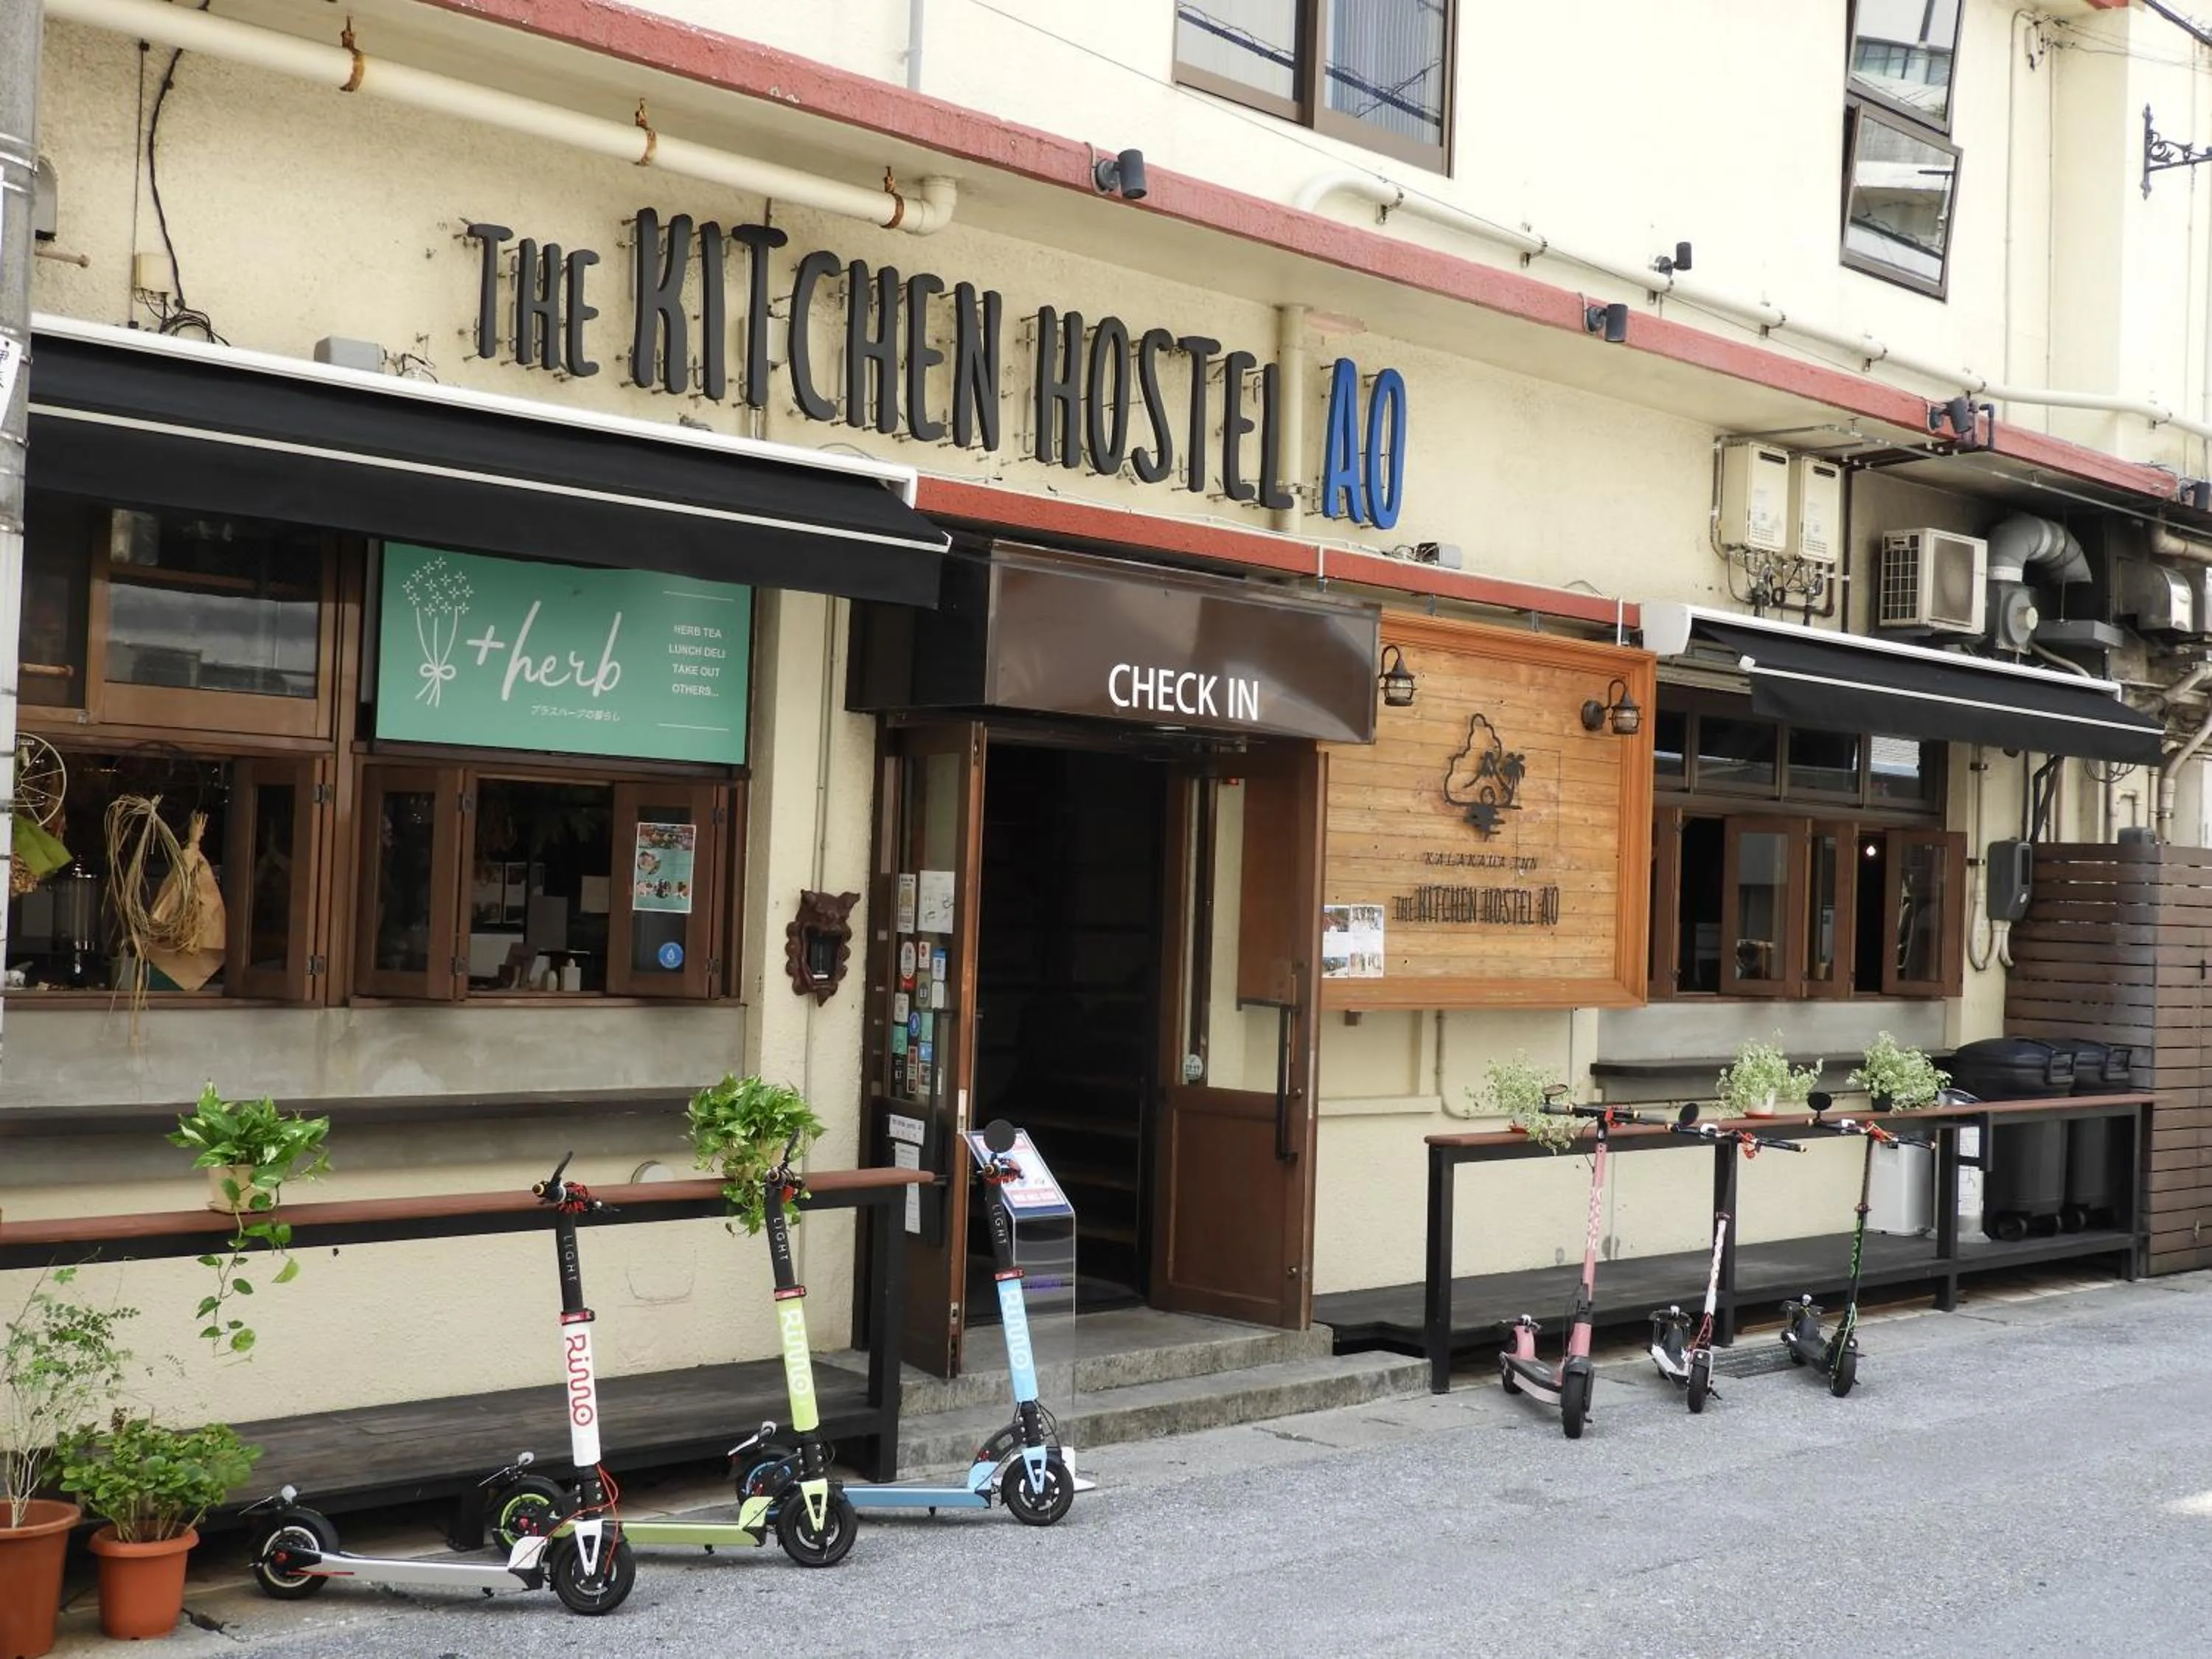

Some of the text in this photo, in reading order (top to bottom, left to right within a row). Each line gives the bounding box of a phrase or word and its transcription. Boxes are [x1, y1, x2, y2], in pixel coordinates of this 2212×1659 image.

[467, 206, 1407, 530] THE KITCHEN HOSTEL AO
[668, 643, 726, 658] LUNCH DELI
[673, 625, 723, 639] HERB TEA
[672, 663, 720, 677] TAKE OUT
[1108, 664, 1259, 721] CHECK IN
[1391, 886, 1559, 926] THE KITCHEN HOSTEL AO
[772, 1217, 789, 1262] LIGHT
[991, 1202, 1008, 1246] LIGHT
[563, 1234, 579, 1283] LIGHT
